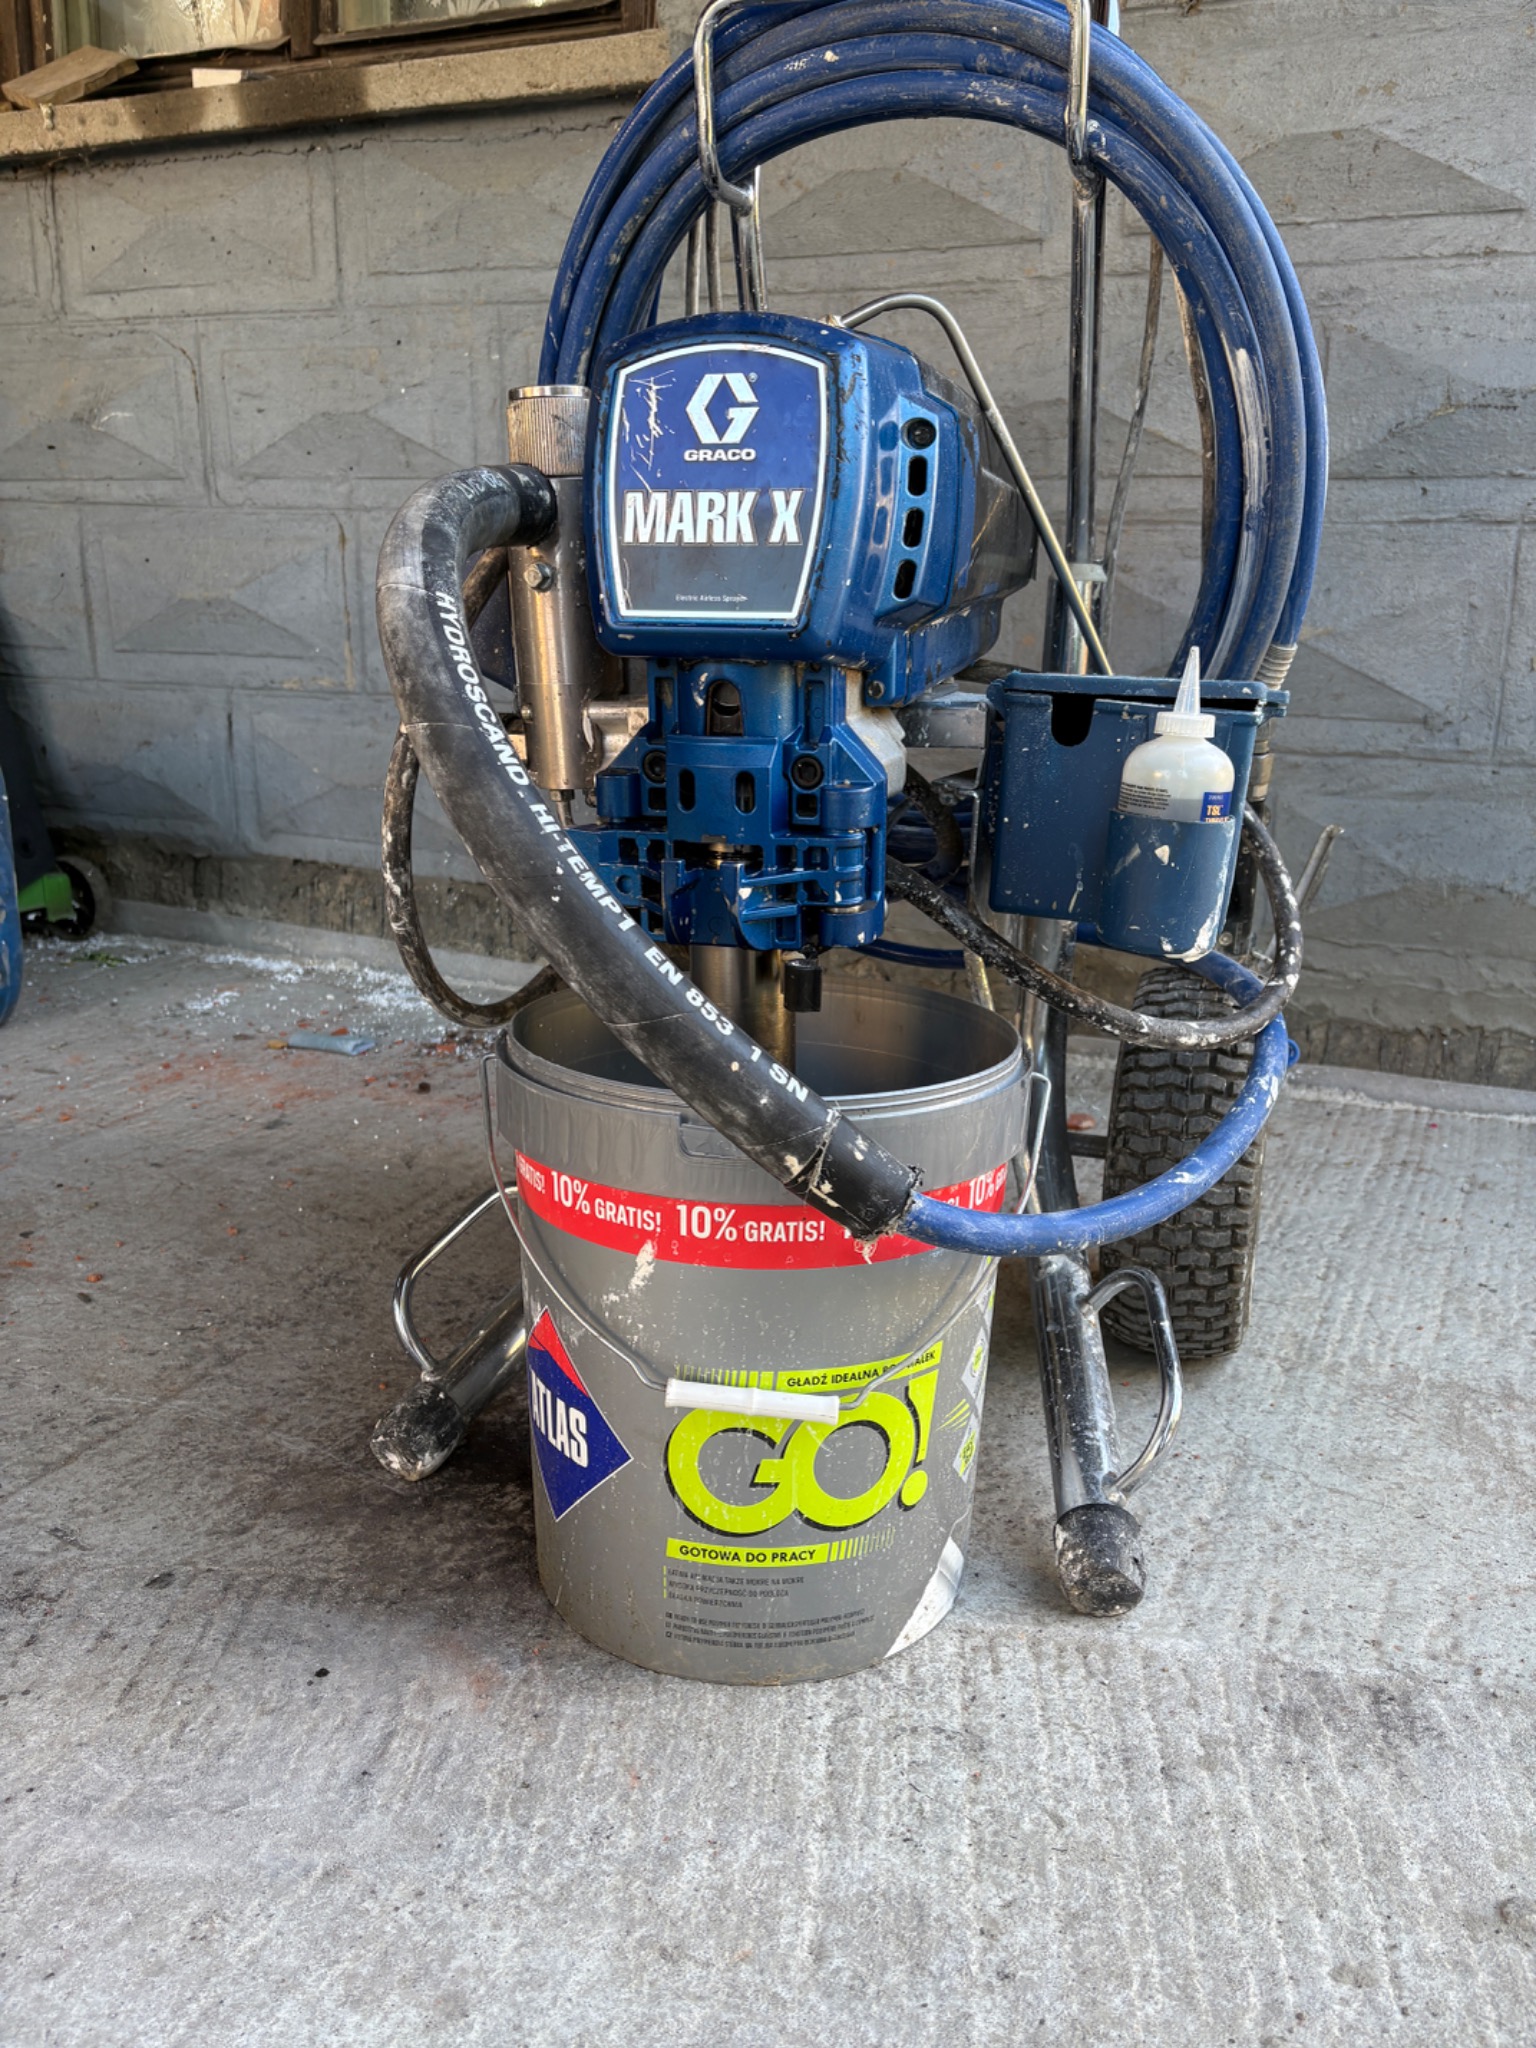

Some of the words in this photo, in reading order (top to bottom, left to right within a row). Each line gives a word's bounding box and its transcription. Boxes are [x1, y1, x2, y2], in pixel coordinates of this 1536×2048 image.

[684, 449, 756, 461] GRACO
[623, 490, 758, 545] MARK
[769, 490, 804, 545] X
[435, 591, 530, 786] HYDROSCAND
[644, 946, 684, 986] EN
[685, 988, 735, 1036] 853
[750, 1045, 762, 1062] 1
[769, 1063, 809, 1103] SN
[551, 1171, 591, 1215] 10%
[594, 1198, 661, 1232] GRATIS!
[676, 1204, 738, 1242] 10%
[744, 1220, 825, 1242] GRATIS!
[969, 1168, 996, 1210] 10%
[786, 1373, 828, 1387] GŁADŹ
[831, 1369, 879, 1384] IDEALNA
[530, 1366, 589, 1468] ATLAS
[664, 1369, 939, 1537] GO!
[679, 1544, 741, 1562] GOTOWA
[745, 1552, 767, 1562] DO
[771, 1549, 816, 1563] PRACY
